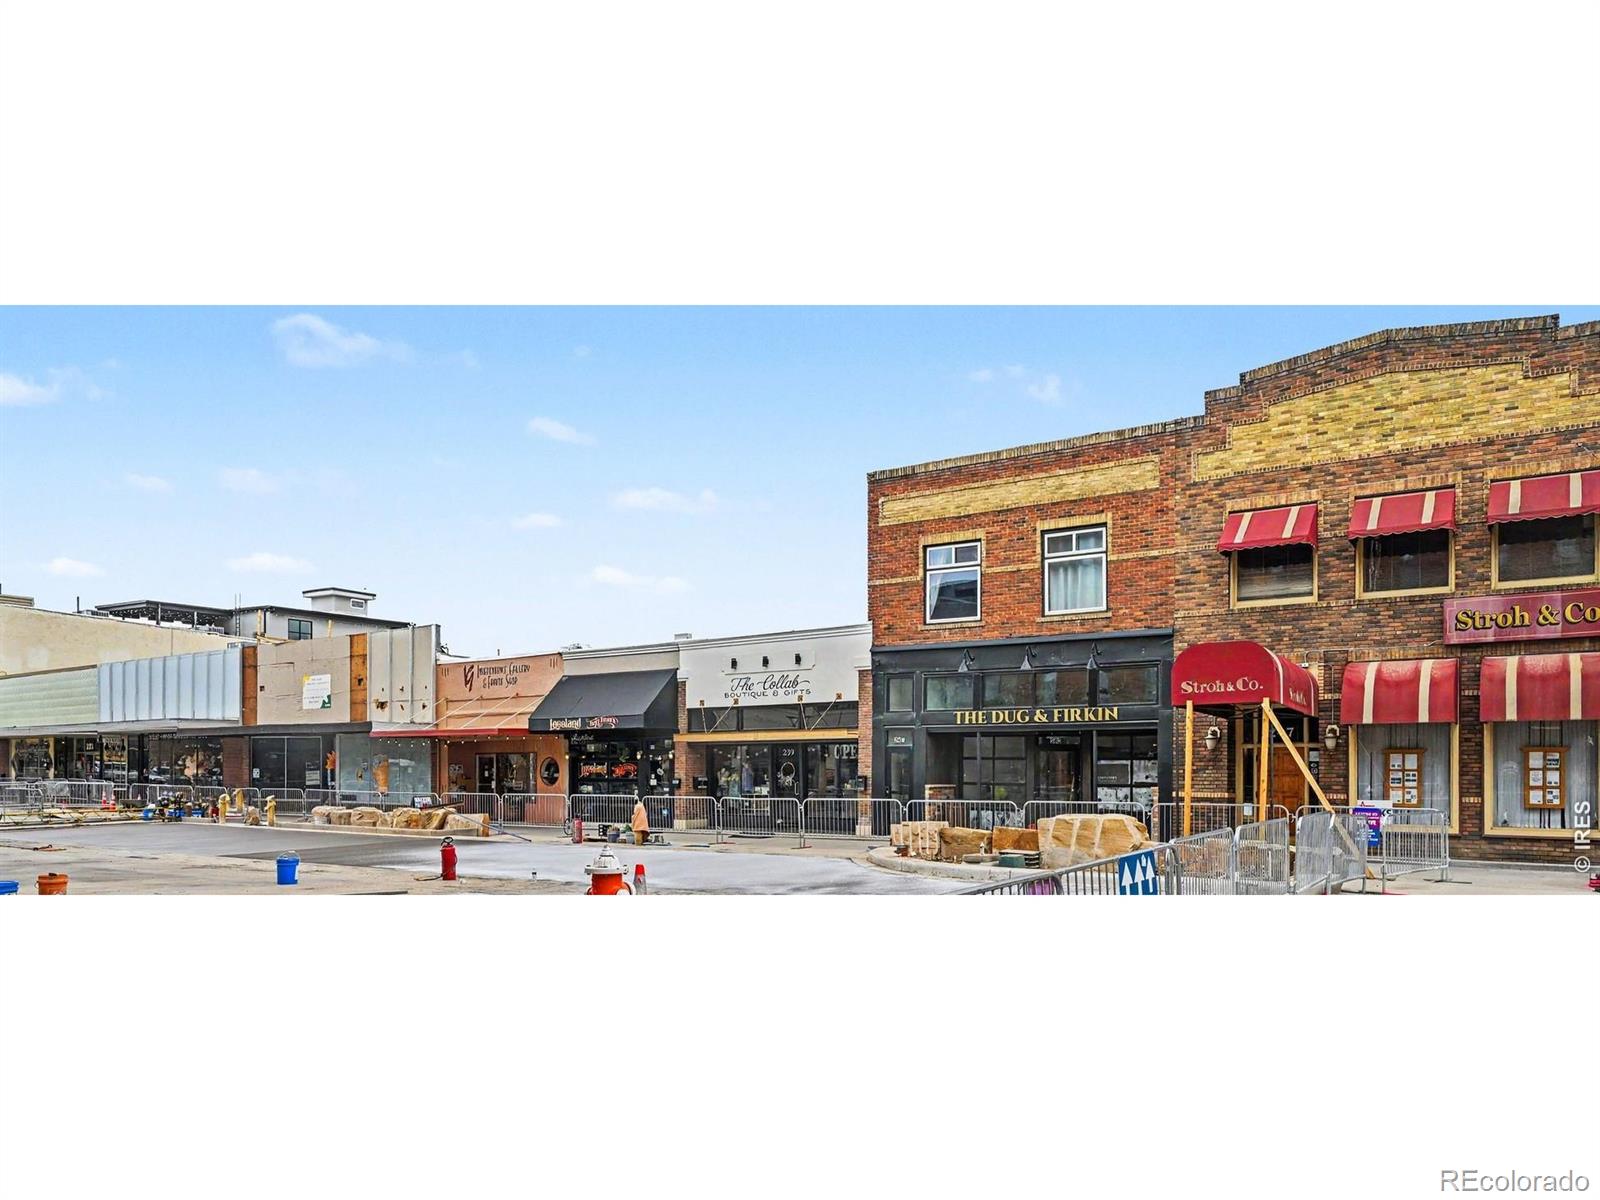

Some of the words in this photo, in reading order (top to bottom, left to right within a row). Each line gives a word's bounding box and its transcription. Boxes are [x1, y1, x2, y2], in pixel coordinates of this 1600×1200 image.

[1455, 605, 1531, 631] Stroh
[1537, 604, 1560, 625] &
[731, 675, 755, 692] The
[757, 673, 811, 691] Collab
[1236, 676, 1264, 692] Co.
[724, 690, 769, 699] BOUTIQUE
[783, 688, 812, 697] GIFTS
[953, 710, 987, 724] THE
[991, 709, 1030, 724] DUG
[1034, 708, 1048, 723] &
[1053, 707, 1118, 722] FIRKIN
